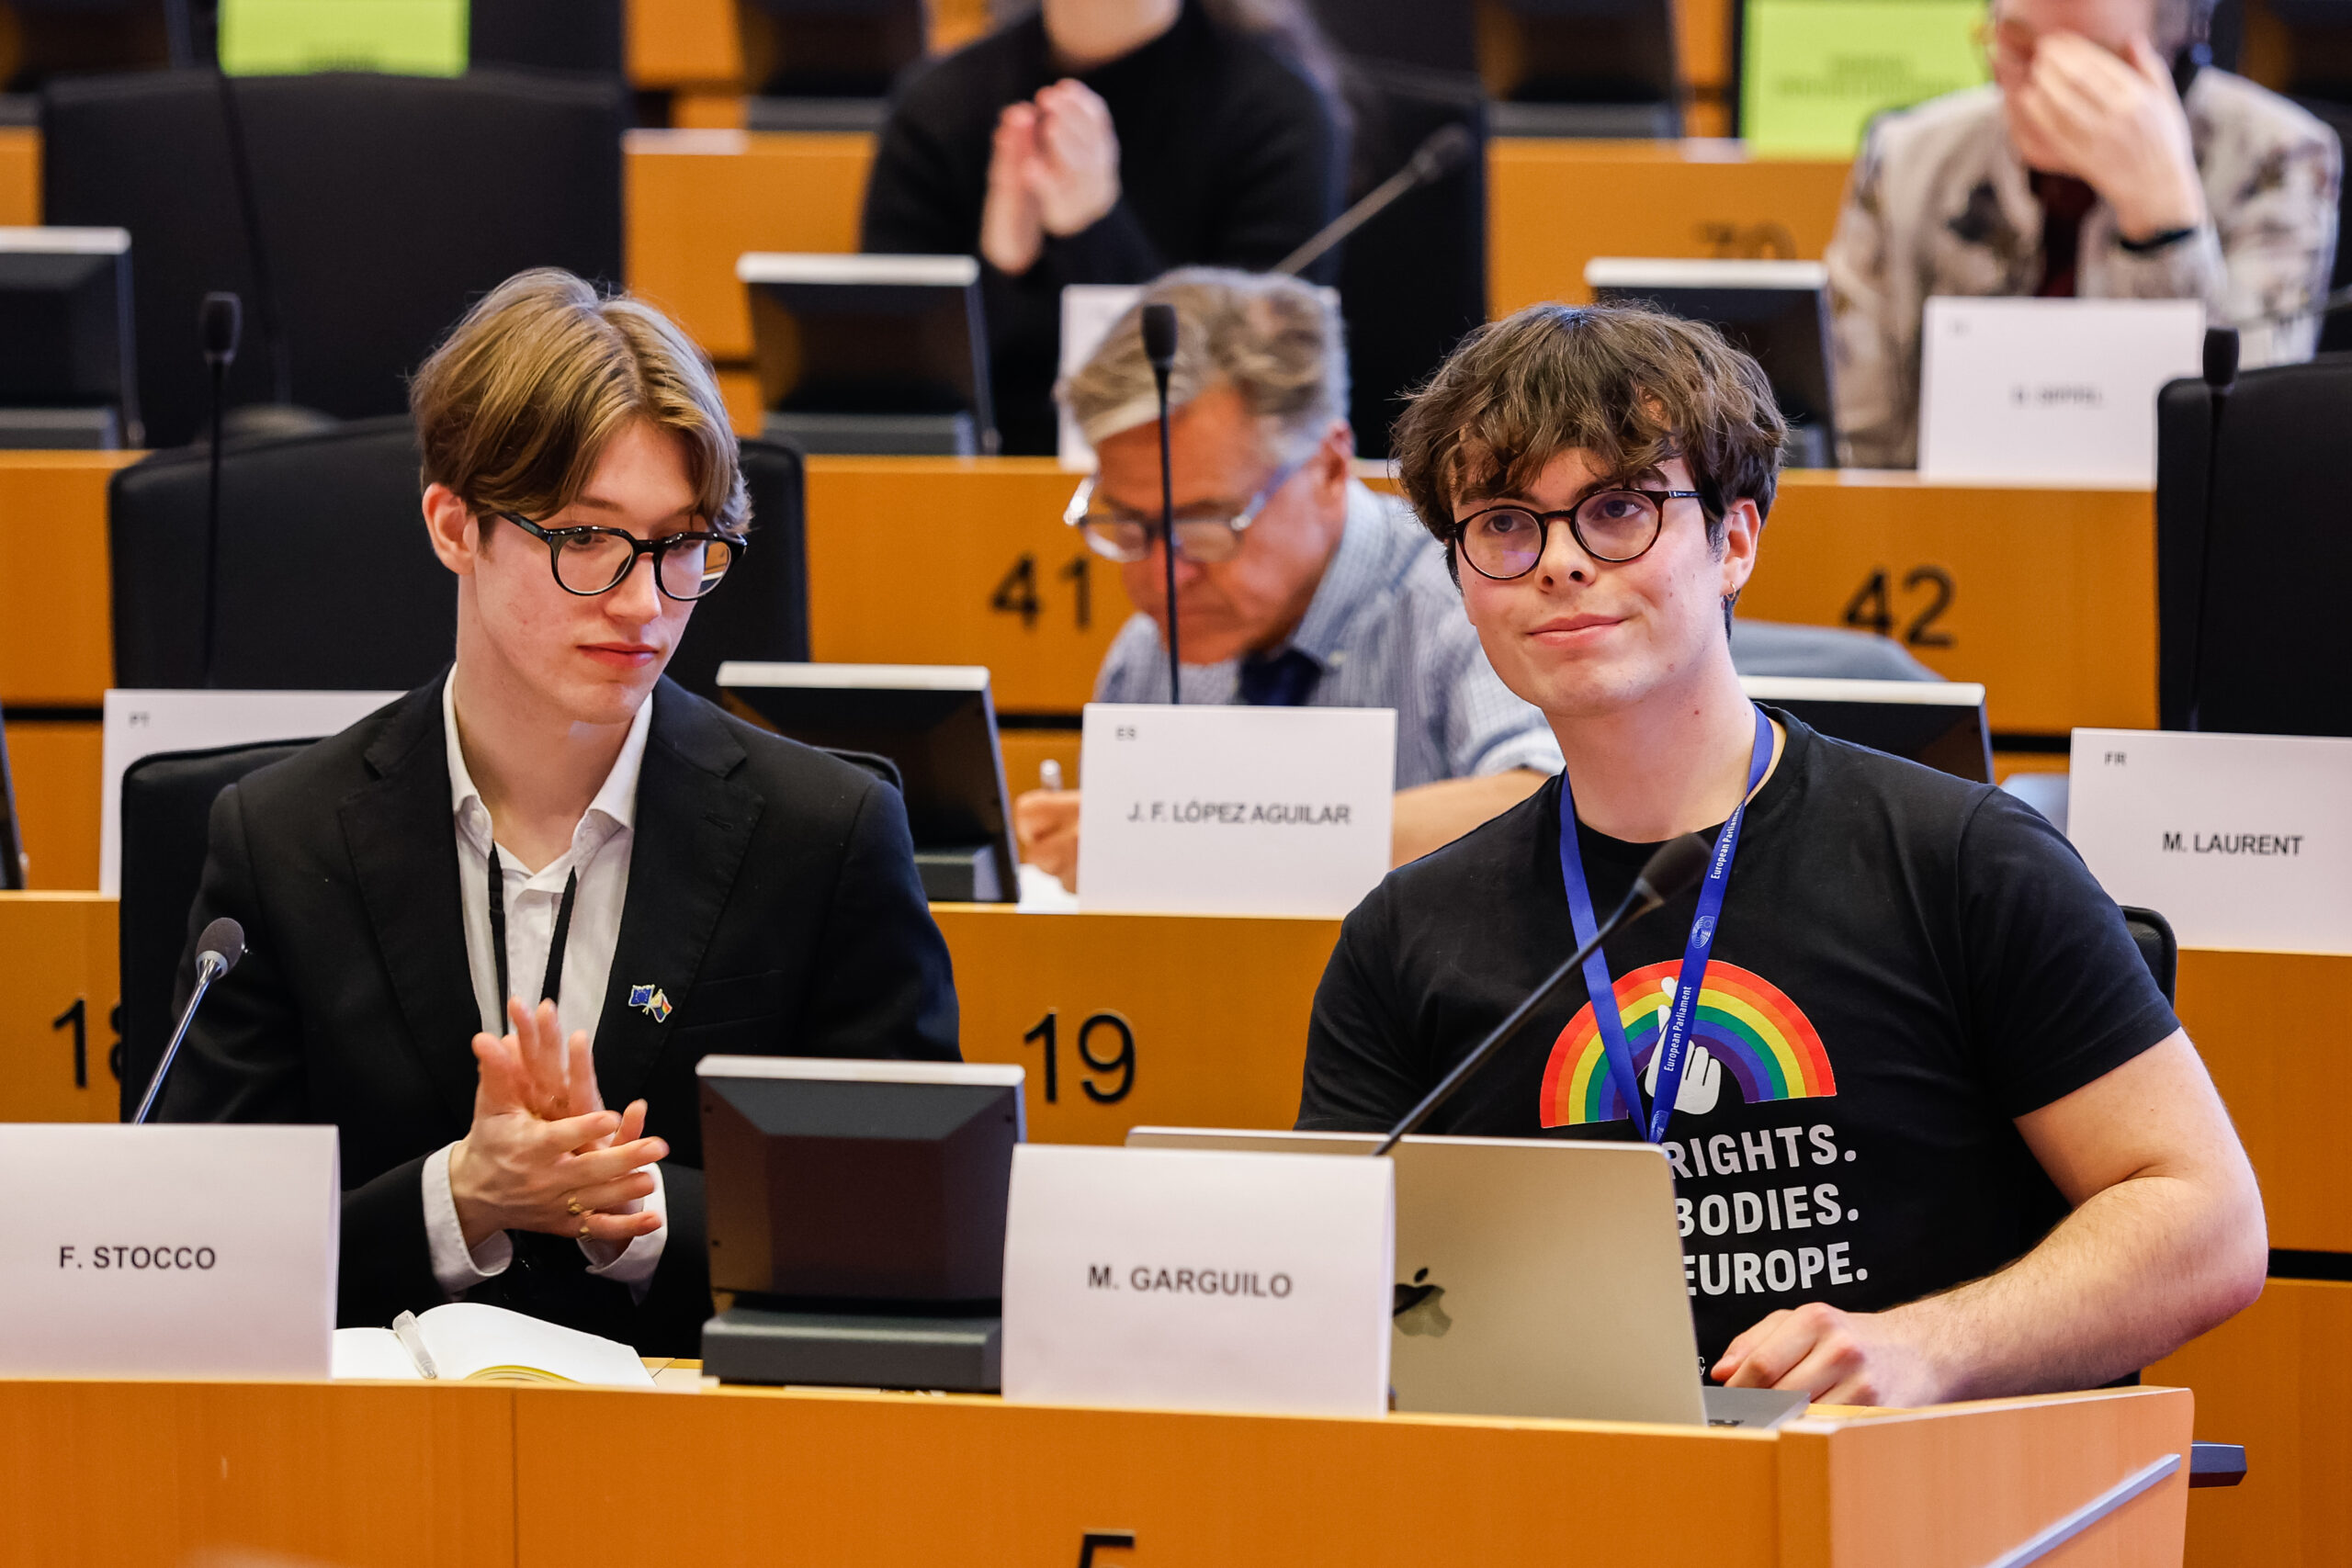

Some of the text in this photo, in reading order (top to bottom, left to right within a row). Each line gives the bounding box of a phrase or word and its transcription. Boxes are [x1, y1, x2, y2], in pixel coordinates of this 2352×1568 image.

[989, 553, 1091, 630] 41
[1841, 567, 1955, 649] 42
[1115, 726, 1137, 741] ES
[2104, 751, 2127, 765] FR
[1127, 798, 1351, 826] J. F. LÓPEZ AGUILAR
[1710, 844, 1729, 880] European
[2163, 831, 2304, 856] M. LAURENT
[52, 998, 121, 1089] 1
[1663, 986, 1692, 1072] European Parliament
[1023, 1011, 1136, 1105] 19
[1664, 1123, 1857, 1180] RIGHTS.
[1675, 1182, 1859, 1237] BODIES.
[59, 1246, 216, 1270] F. STOCCO
[1088, 1263, 1293, 1299] M. GARGUILO
